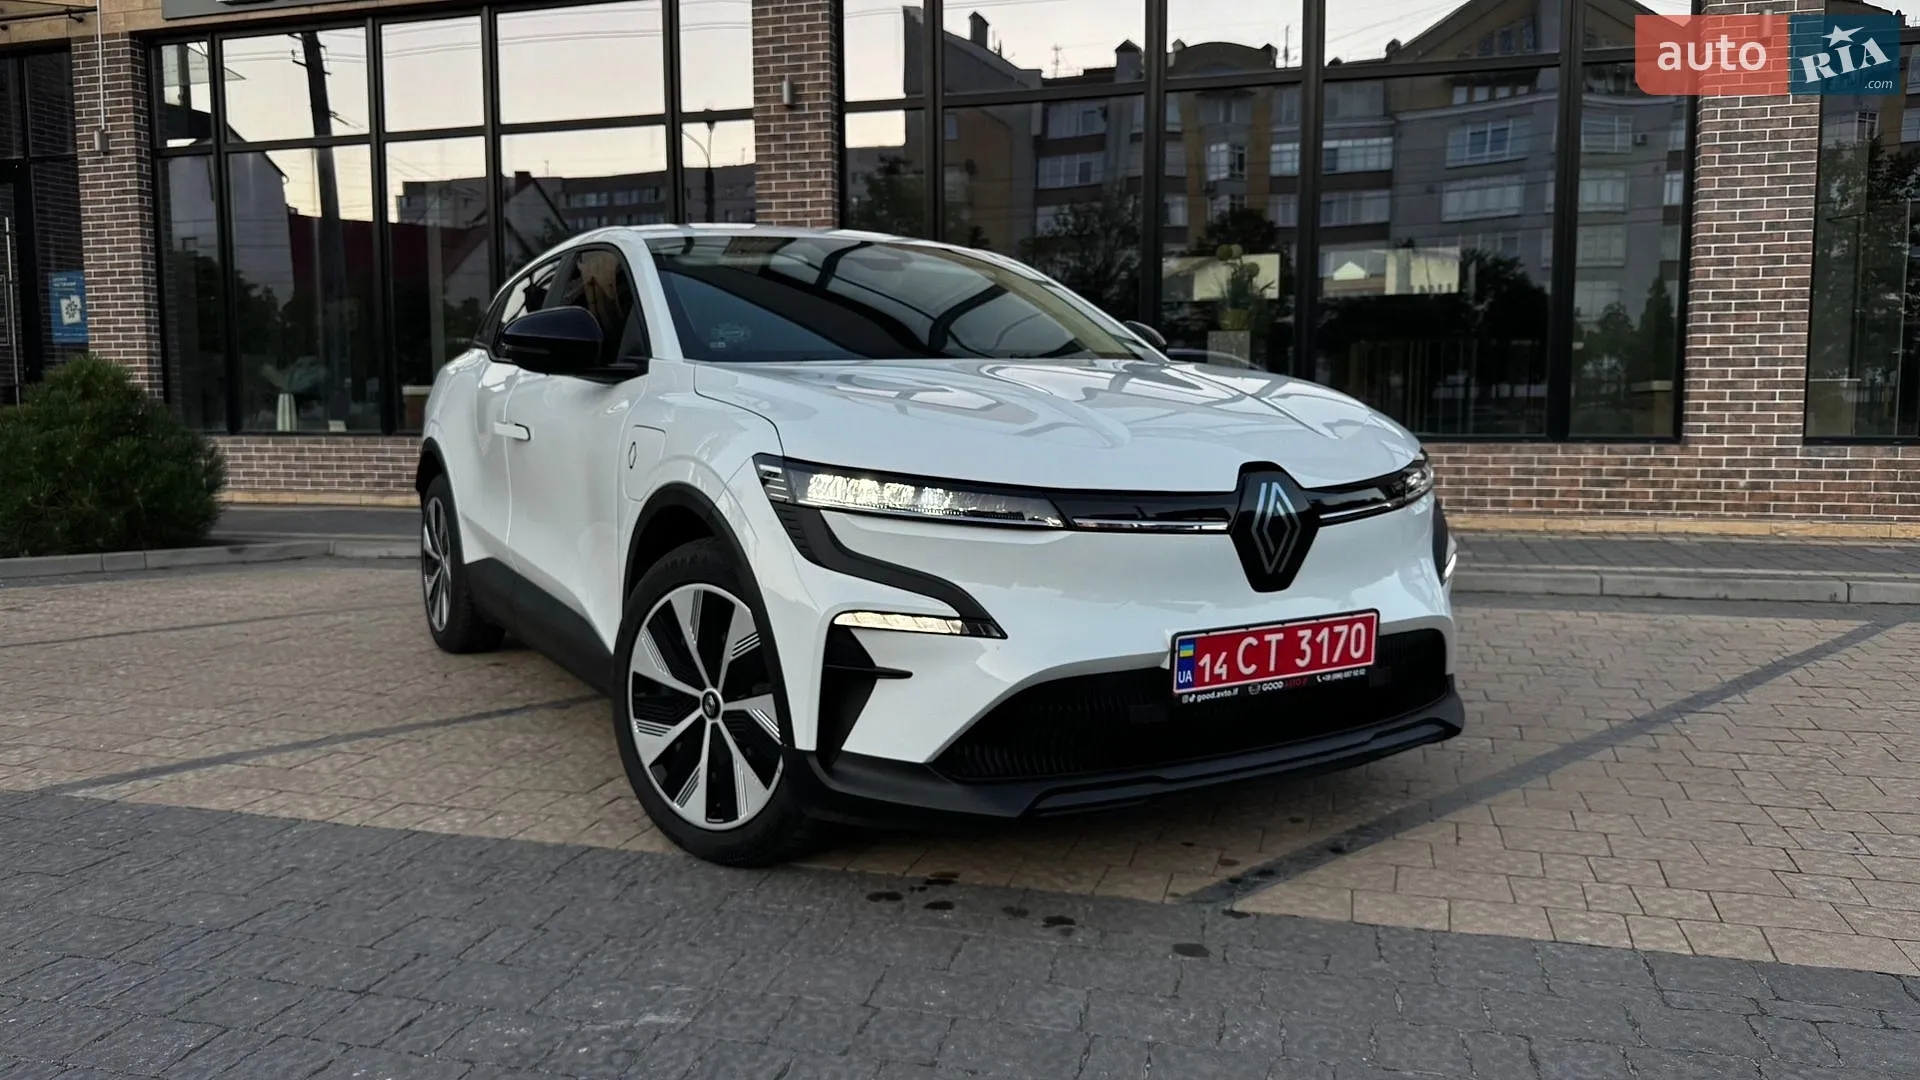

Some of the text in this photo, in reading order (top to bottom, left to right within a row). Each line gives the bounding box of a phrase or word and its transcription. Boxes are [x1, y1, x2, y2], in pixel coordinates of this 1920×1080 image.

[1198, 622, 1366, 683] 14 CT 3170
[1178, 670, 1193, 684] UA
